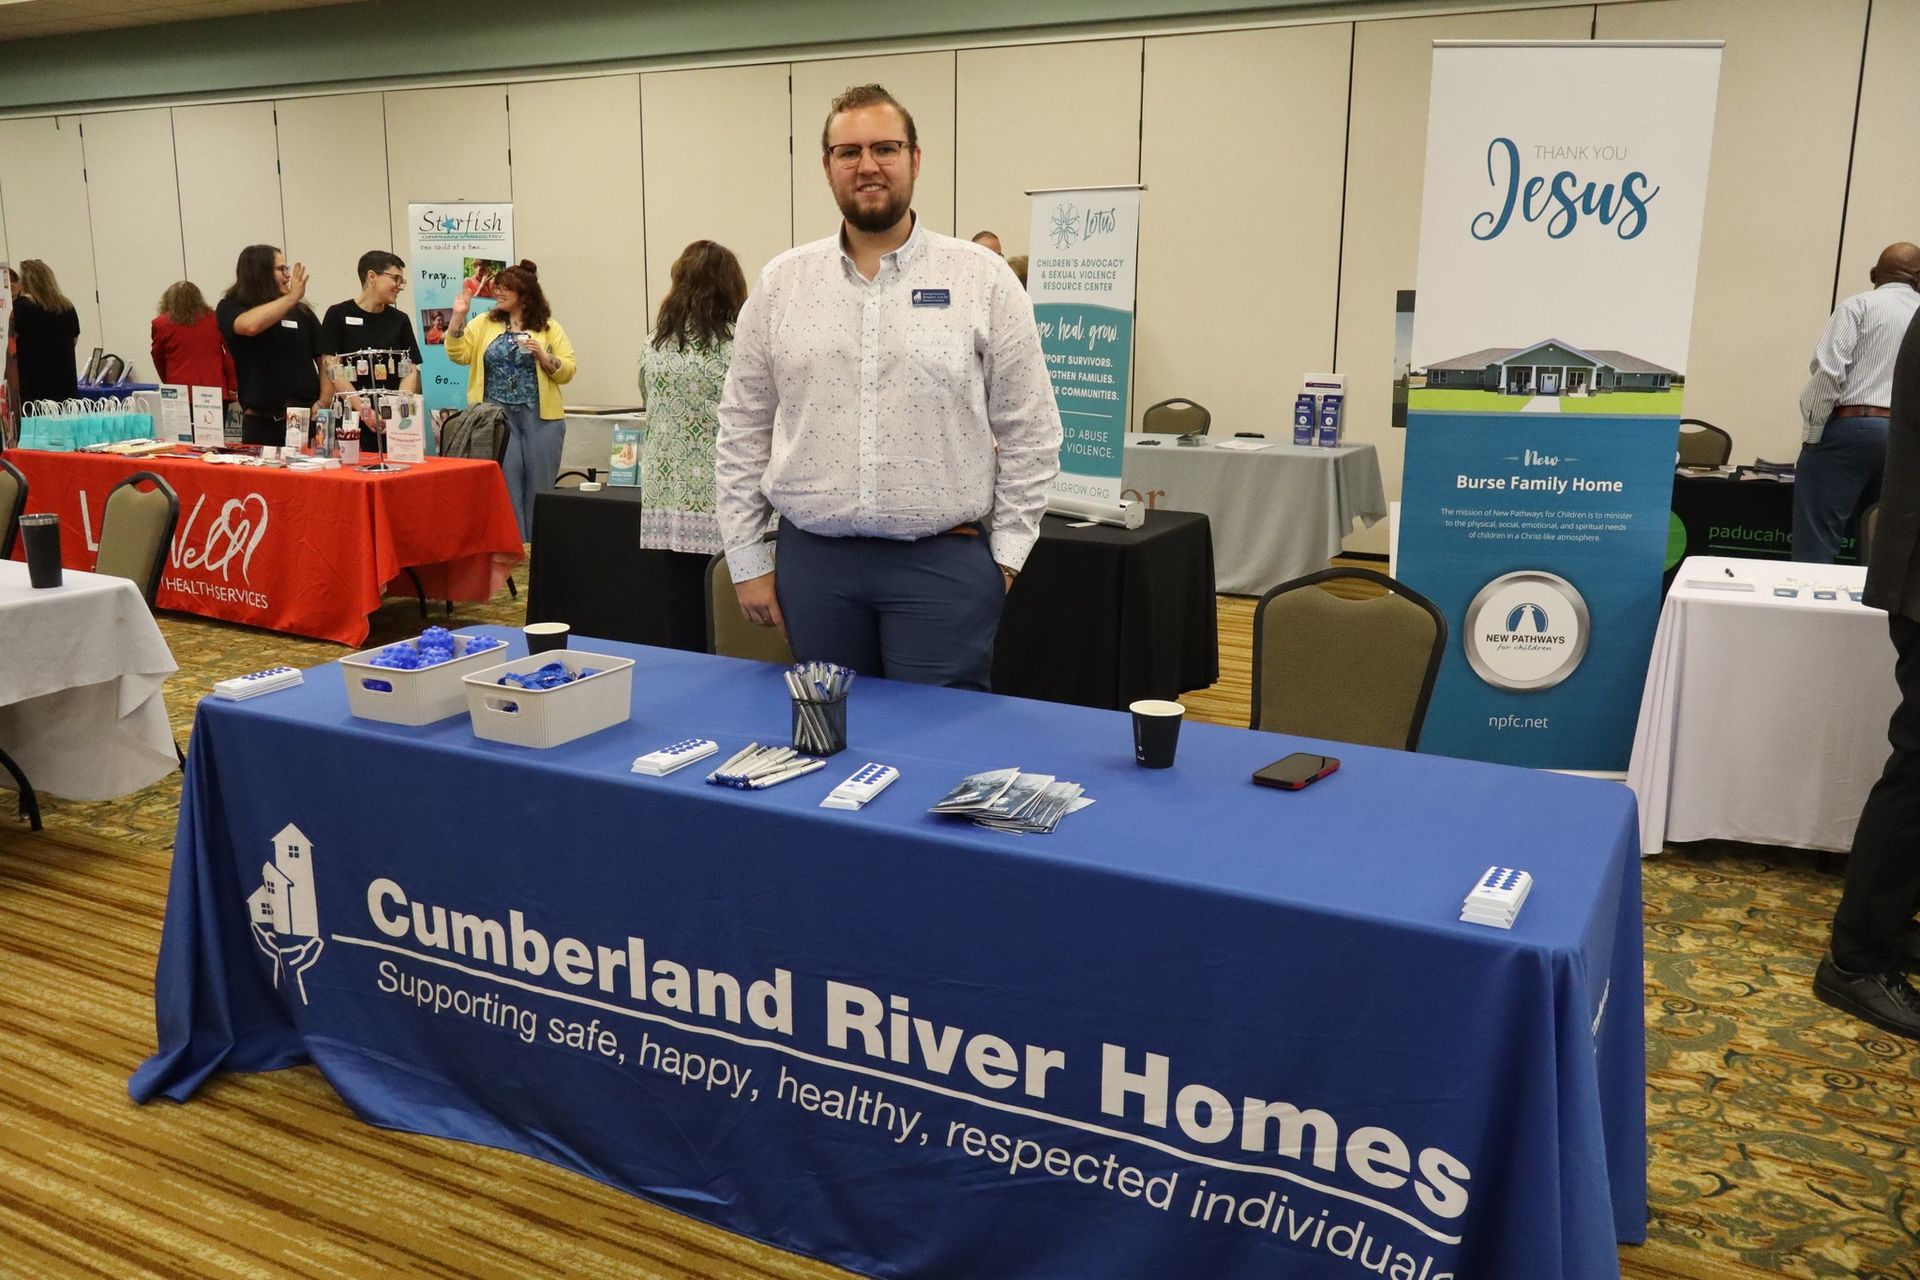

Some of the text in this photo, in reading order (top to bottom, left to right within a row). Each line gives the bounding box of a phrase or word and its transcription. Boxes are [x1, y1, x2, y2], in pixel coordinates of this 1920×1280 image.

[1533, 145, 1628, 161] THANK YOU
[1471, 137, 1660, 241] Jesus
[1083, 207, 1116, 241] Lotus
[1036, 258, 1125, 268] CHILDREN'S ADVOCACY
[1048, 270, 1077, 279] SEXUAL
[1080, 270, 1117, 280] VIOLENCE
[1043, 281, 1113, 291] RESOURCE CENTER
[1036, 321, 1055, 340] ope.
[1088, 324, 1119, 351] grow.
[1043, 353, 1113, 367] PPORT SURVIVORS.
[1078, 372, 1115, 384] FAMILIES.
[1061, 386, 1119, 400] COMMUNITIES.
[1078, 429, 1108, 442] ABUSE
[1066, 443, 1115, 459] VIOLENCE.
[1523, 449, 1561, 467] New
[1051, 480, 1110, 498] ALGROW.ORG
[1456, 474, 1623, 495] Burse Family Home
[1441, 508, 1633, 520] The mission of New Pathways for Children is to minister
[1454, 519, 1466, 527] the
[1467, 520, 1497, 530] physical,
[1498, 520, 1520, 529] social,
[1521, 521, 1559, 530] emotional,
[1560, 522, 1574, 530] and
[1575, 522, 1604, 532] spiritual
[1605, 523, 1627, 531] needs
[1468, 531, 1477, 539] of
[1477, 531, 1506, 539] children
[1521, 532, 1556, 540] Christ-like
[1486, 633, 1566, 645] NEW PATHWAYS
[1489, 714, 1549, 730] npfc.net
[367, 878, 1471, 1219] Cumberland River Homes
[377, 960, 1455, 1280] Supporting safe, happy, healthy, respected individual
